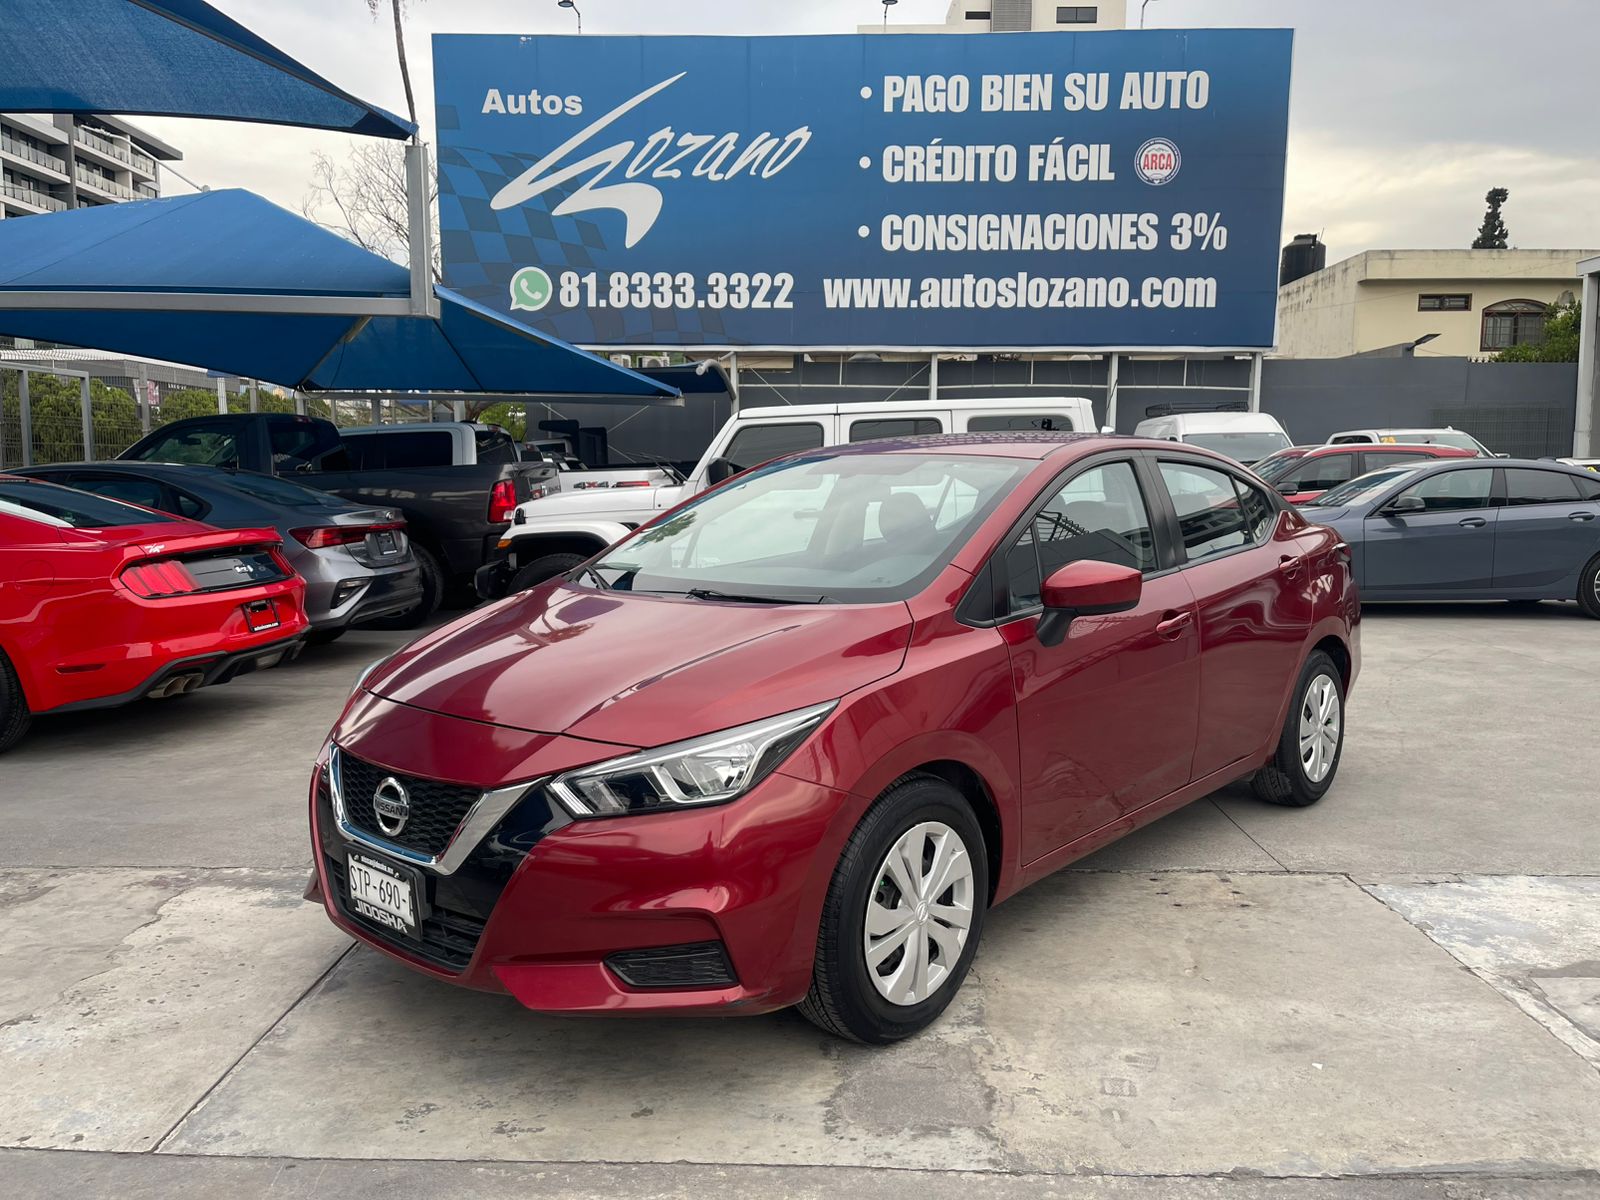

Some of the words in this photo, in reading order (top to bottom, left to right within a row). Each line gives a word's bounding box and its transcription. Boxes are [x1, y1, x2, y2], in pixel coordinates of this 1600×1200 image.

[481, 88, 584, 115] Autos
[883, 74, 970, 113] PAGO
[980, 73, 1053, 112] BIEN
[1063, 72, 1109, 111] SU
[1119, 70, 1210, 110] AUTO
[882, 138, 1017, 183] CRÉDITO
[1028, 136, 1115, 182] FÁCIL
[1143, 153, 1172, 170] ARCA
[881, 212, 1158, 252] CONSIGNACIONES
[1169, 211, 1228, 251] 3%
[559, 271, 794, 308] 81.8333.3322
[823, 272, 1217, 308] www.autoslozano.com
